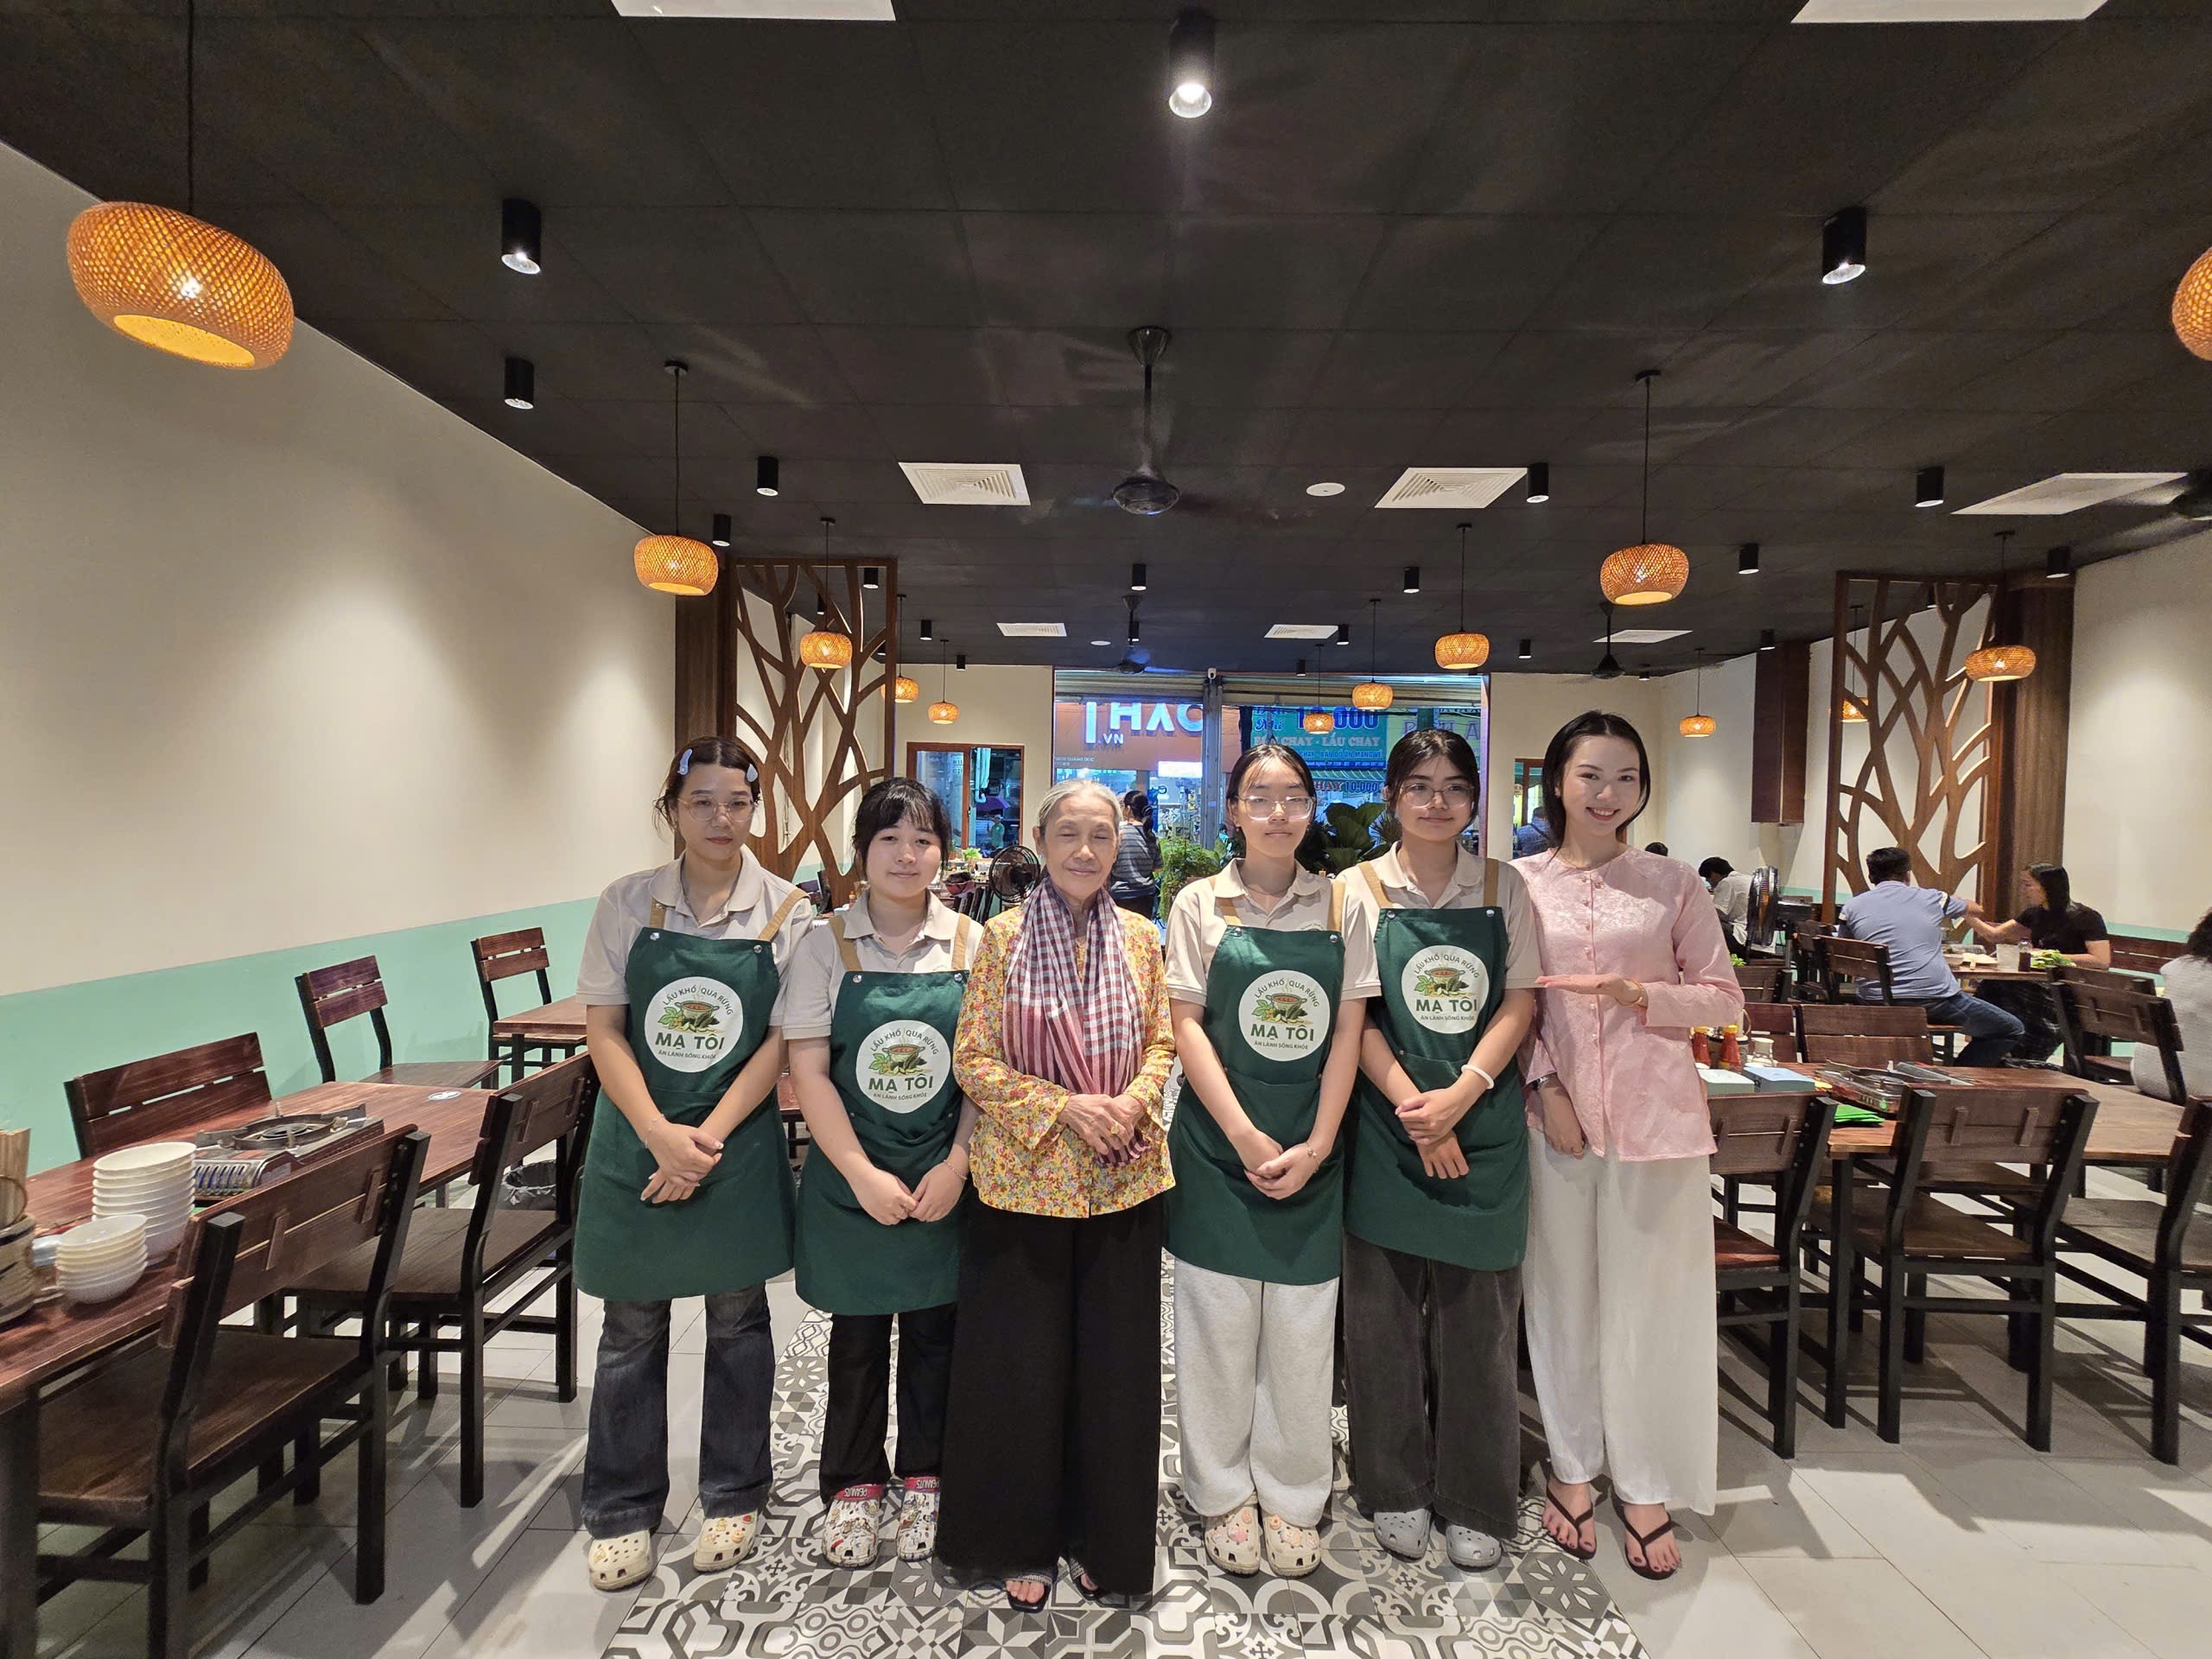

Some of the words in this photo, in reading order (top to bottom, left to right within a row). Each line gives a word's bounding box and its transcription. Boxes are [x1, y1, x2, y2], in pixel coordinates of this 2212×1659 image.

[1281, 735, 1314, 747] CHAY
[1348, 735, 1382, 747] CHAY
[1313, 780, 1344, 791] HAY
[1344, 780, 1380, 792] 10.000
[1444, 954, 1460, 964] QUA
[1288, 980, 1305, 991] QUA
[700, 987, 718, 999] QUA
[1449, 996, 1477, 1012] TÔI
[906, 1029, 923, 1039] QUA
[1286, 1024, 1314, 1041] TÔI
[693, 1033, 725, 1051] TÔI
[905, 1073, 933, 1090] TÔI
[916, 1478, 940, 1489] PEANUTS
[843, 1487, 868, 1497] PEANUTS
